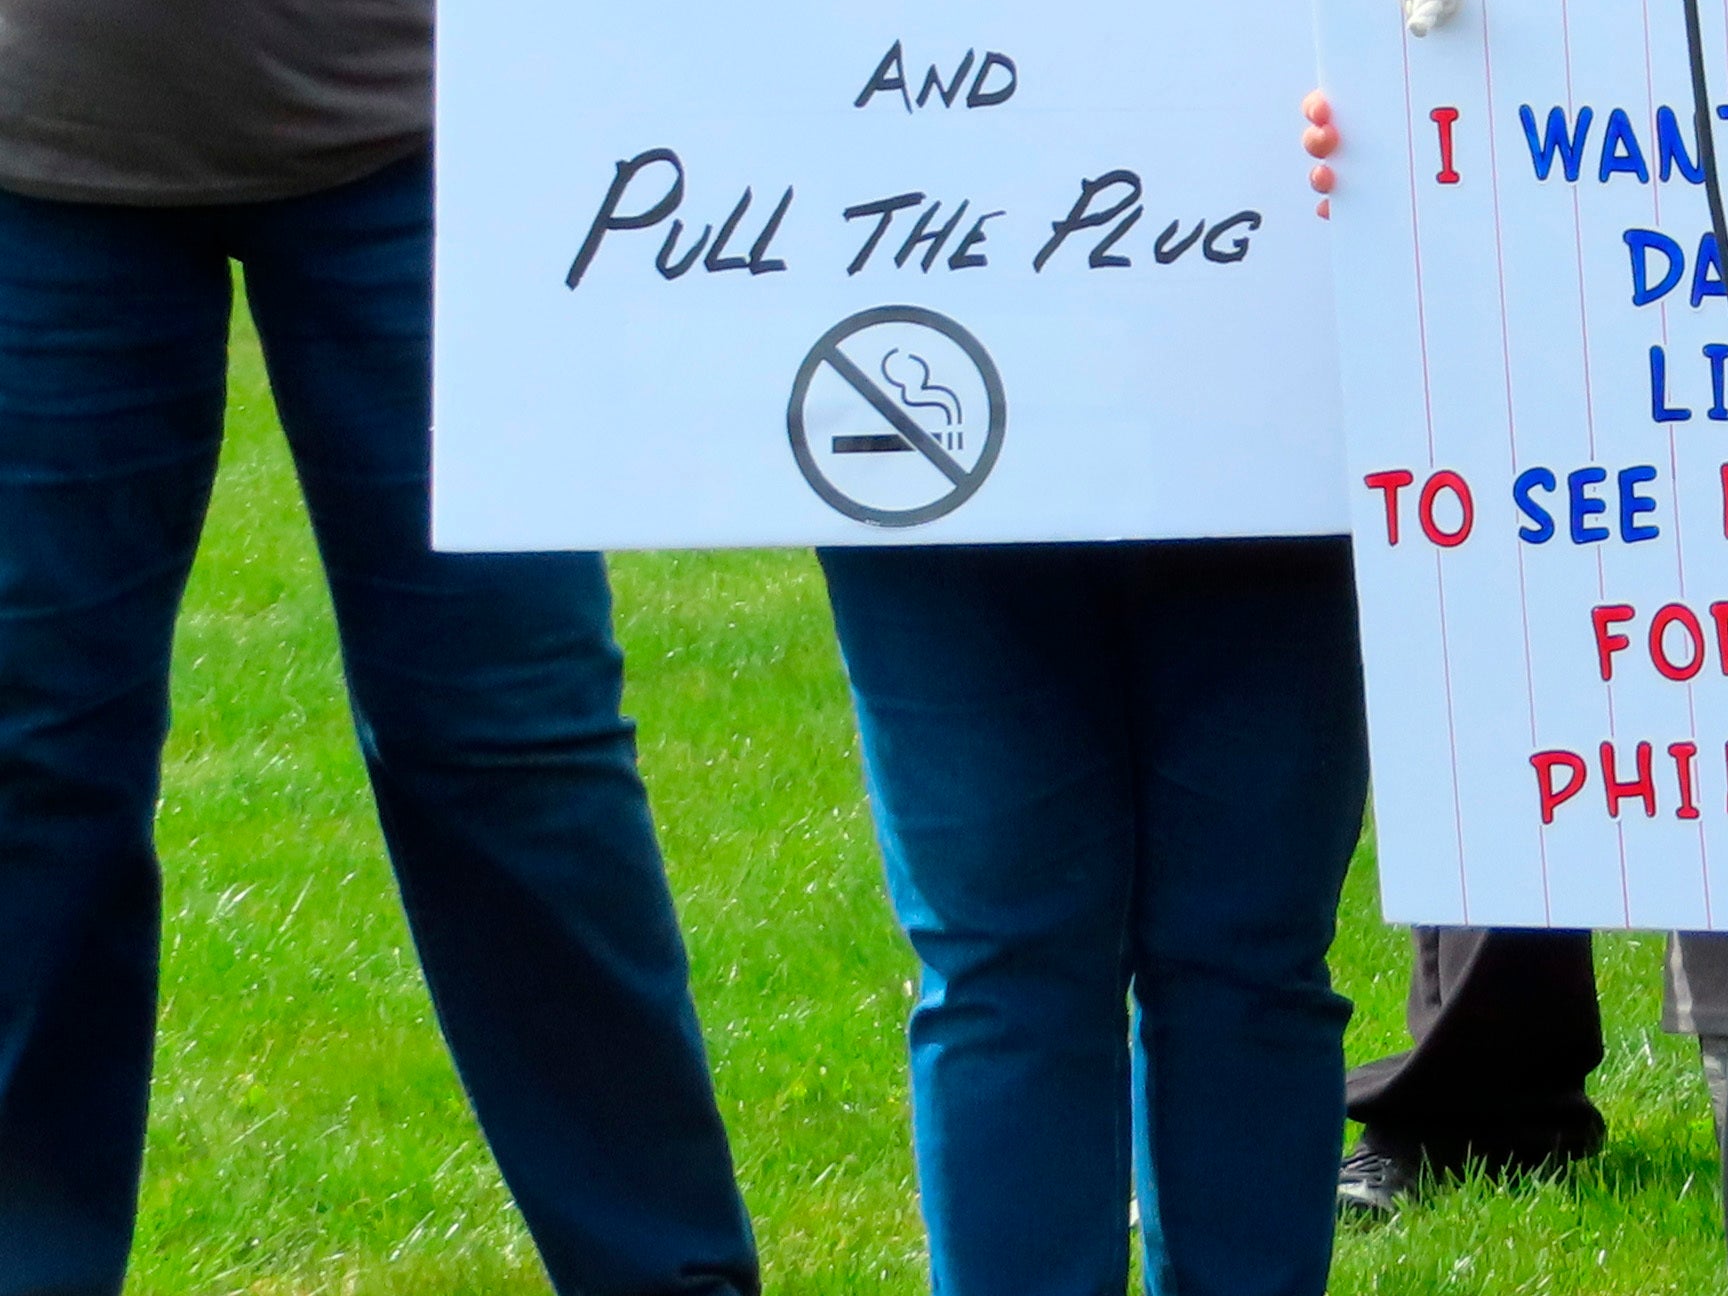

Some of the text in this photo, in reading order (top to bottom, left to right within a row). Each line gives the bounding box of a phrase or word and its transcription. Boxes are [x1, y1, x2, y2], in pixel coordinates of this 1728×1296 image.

[854, 38, 1018, 115] AND
[1431, 106, 1461, 185] I
[564, 147, 1263, 291] PULL THE PLUG
[1365, 468, 1475, 548] TO
[1513, 464, 1661, 543] SEE
